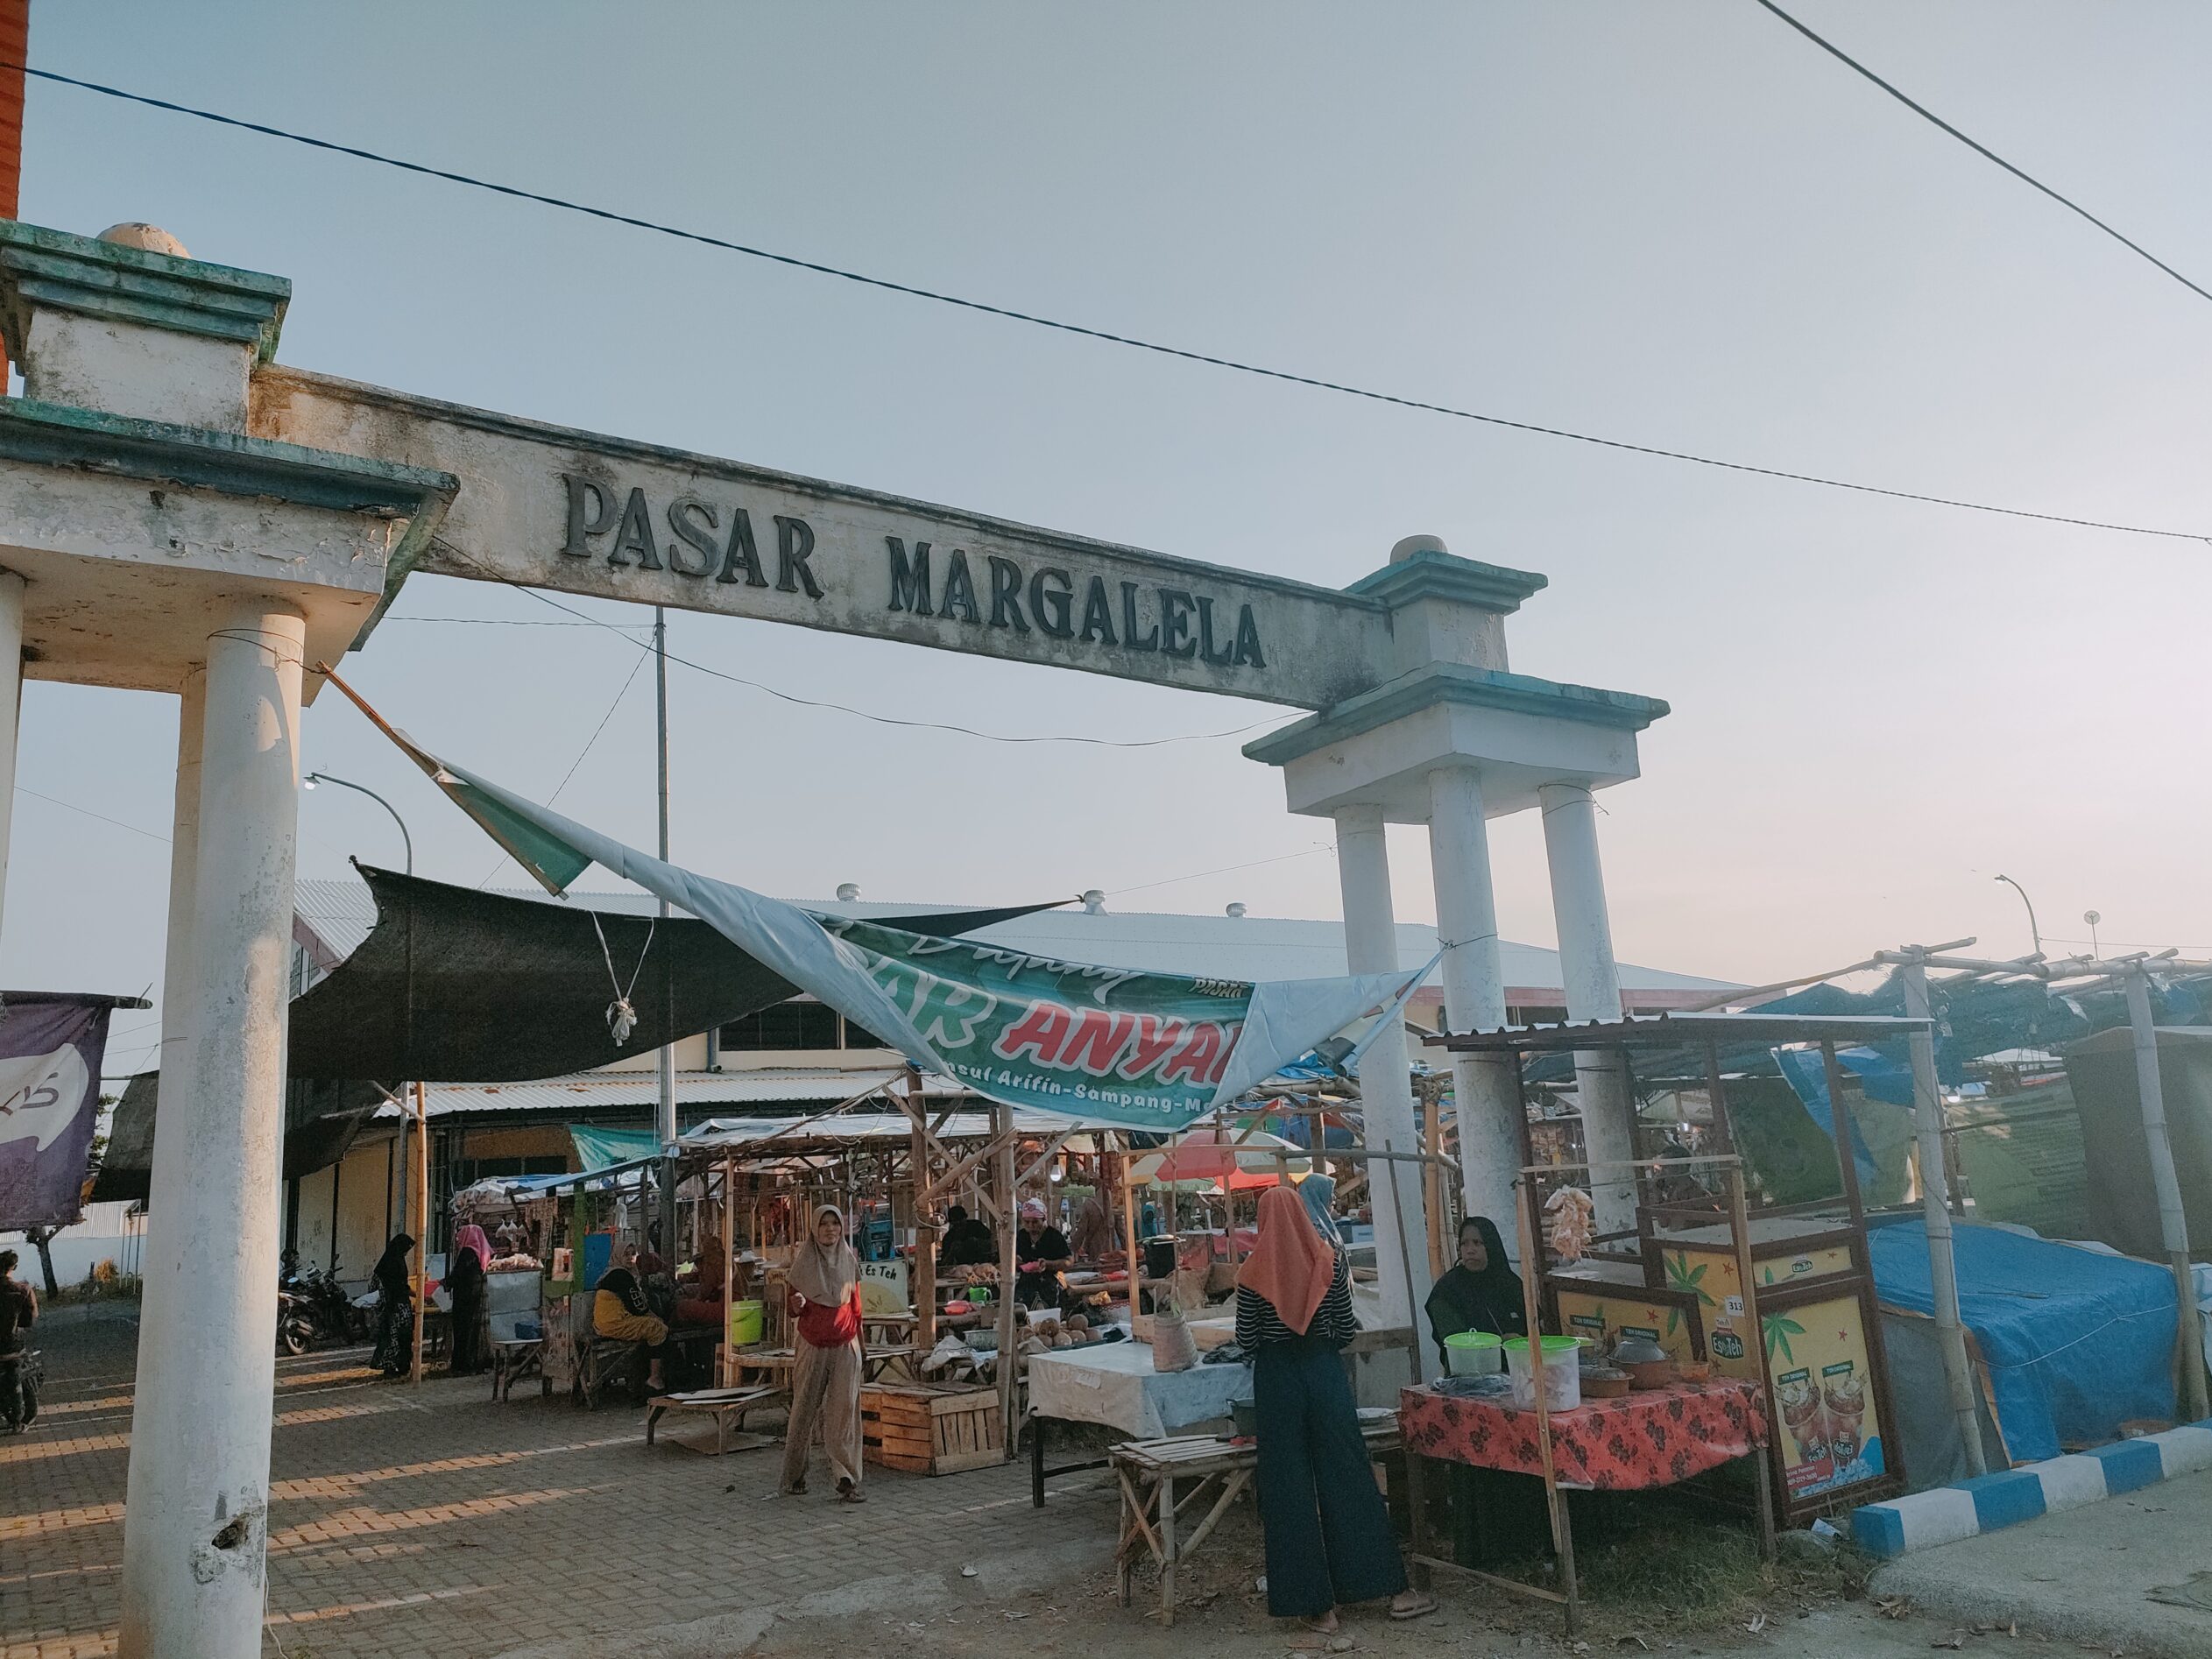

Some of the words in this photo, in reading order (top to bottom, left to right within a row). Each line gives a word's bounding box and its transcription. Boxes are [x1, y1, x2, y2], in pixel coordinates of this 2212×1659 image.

[562, 473, 824, 598] PASAR
[885, 536, 1267, 668] MARGALELA
[866, 1264, 876, 1276] Es
[880, 1266, 897, 1280] Teh
[1729, 1302, 1743, 1311] 313
[1726, 1337, 1742, 1356] Teh
